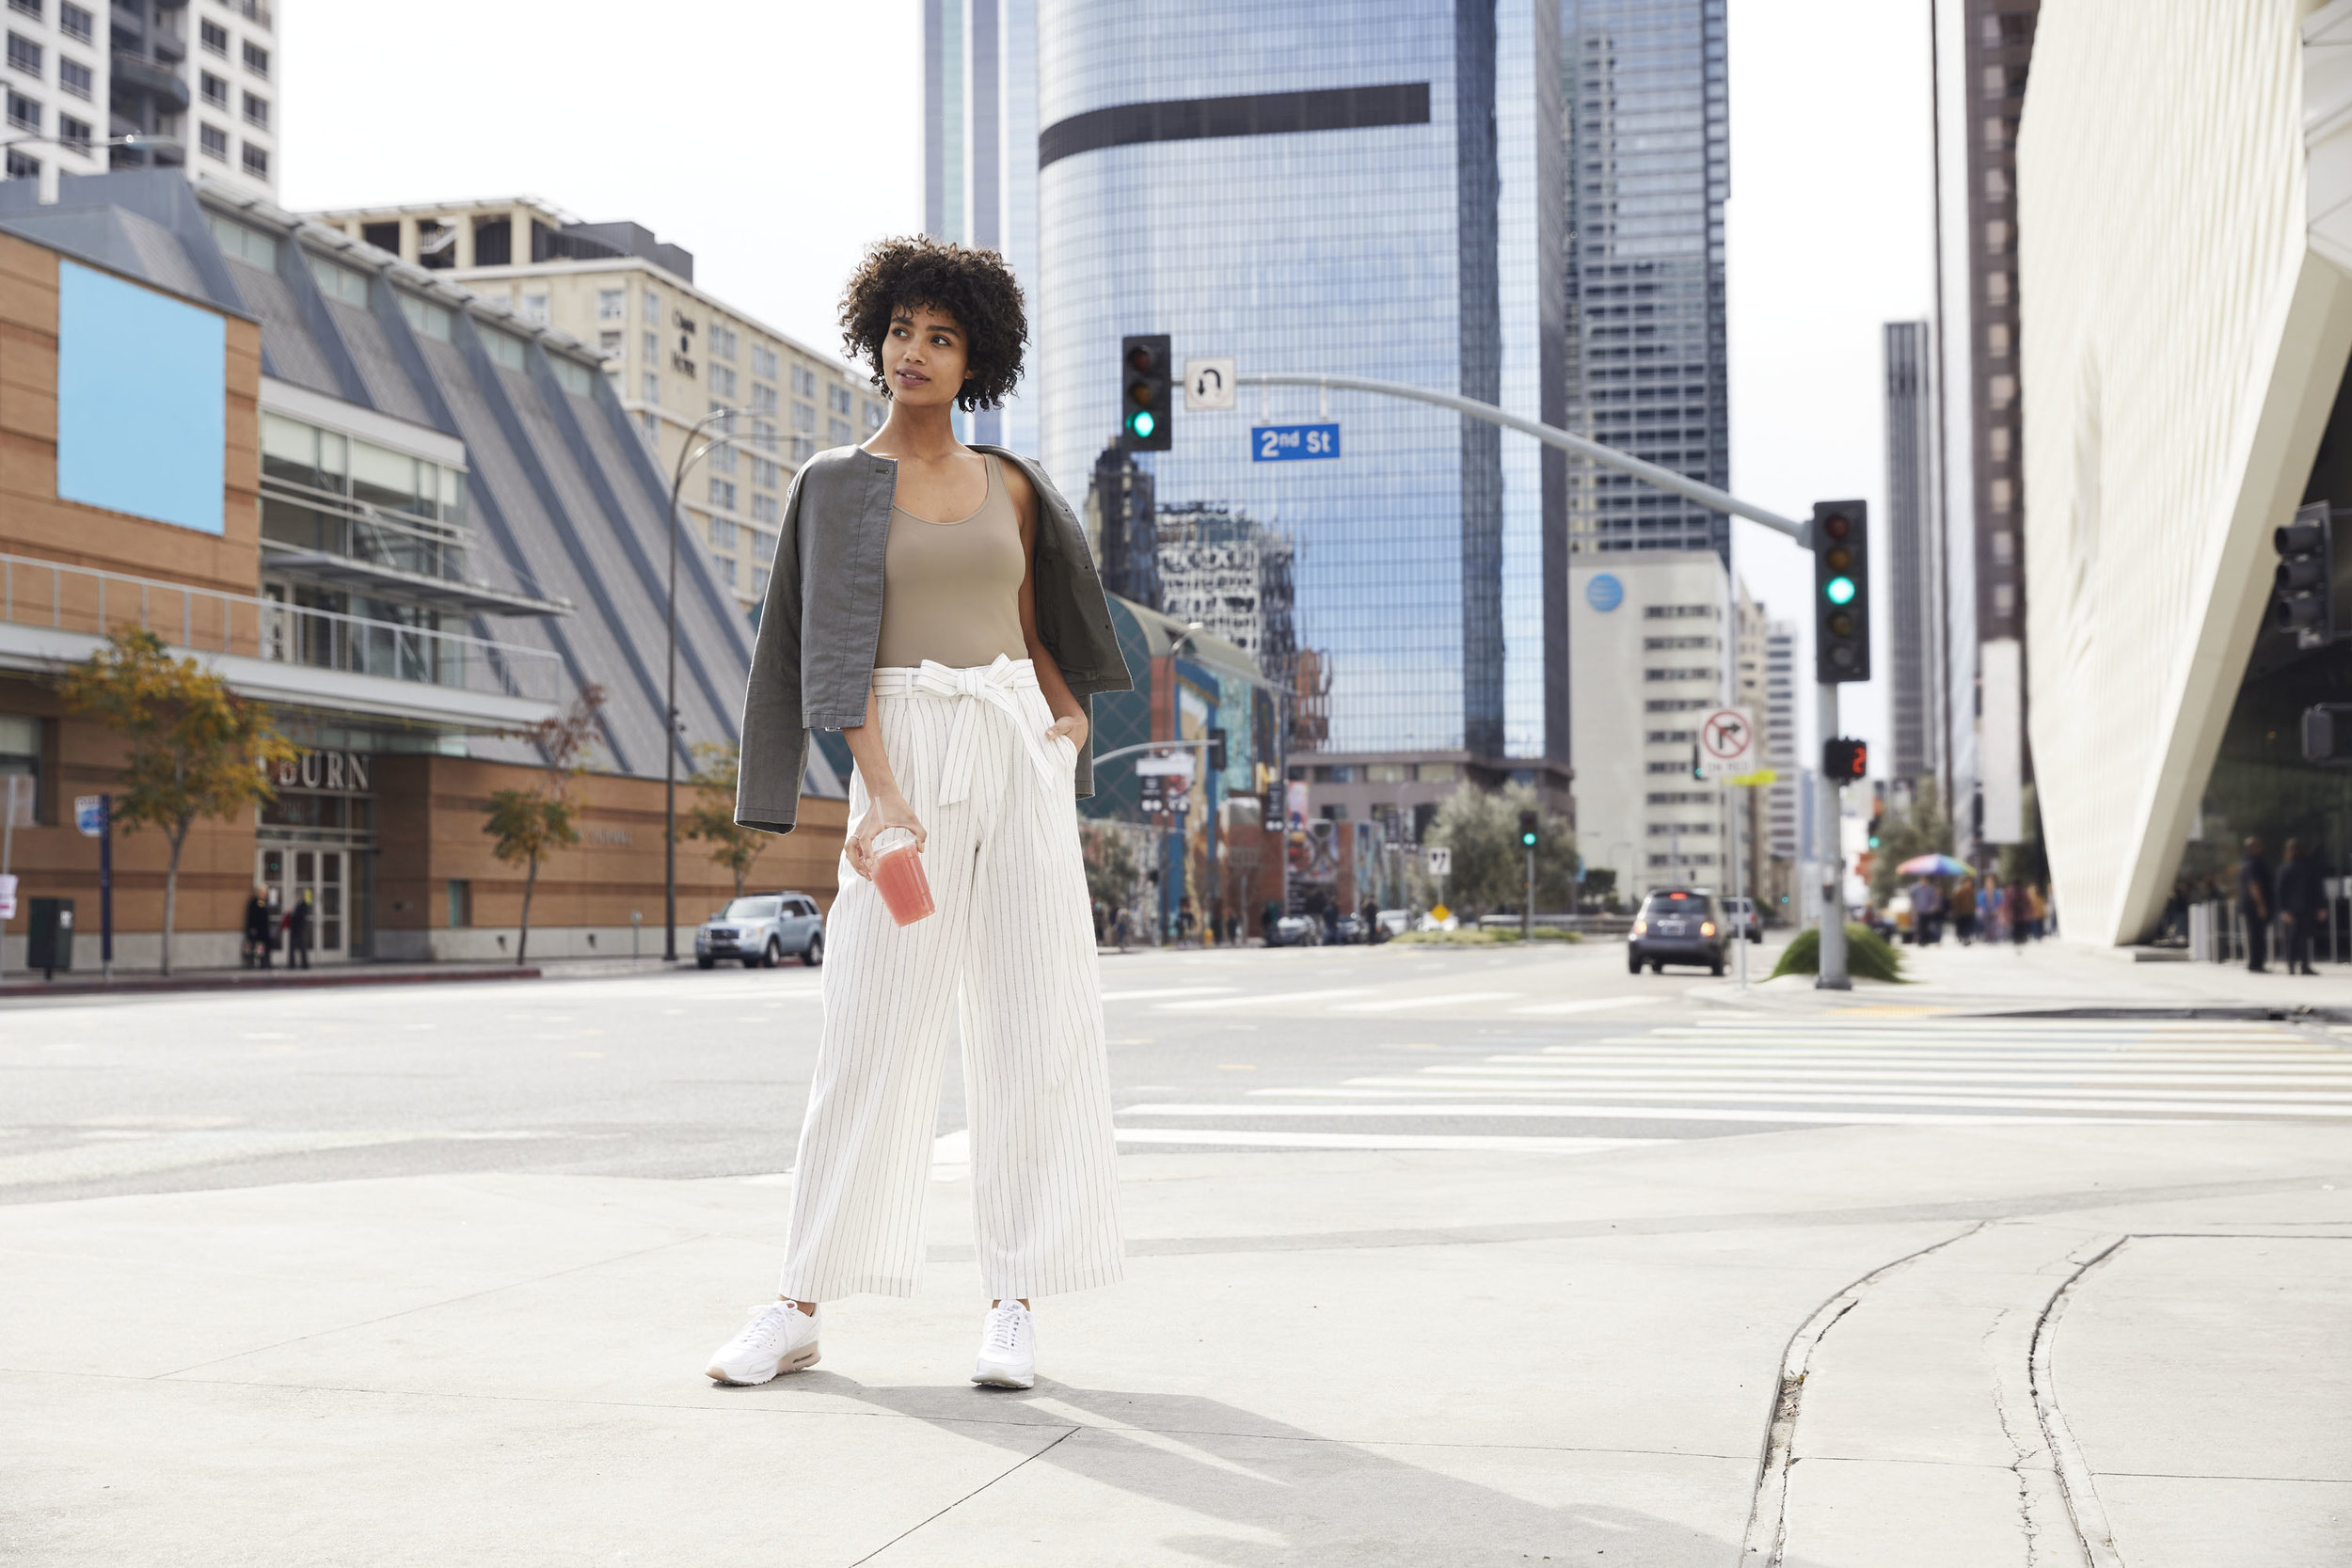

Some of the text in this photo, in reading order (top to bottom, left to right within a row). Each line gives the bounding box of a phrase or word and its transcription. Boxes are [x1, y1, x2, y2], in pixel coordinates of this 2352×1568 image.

[1261, 429, 1331, 458] 2nd St
[1851, 747, 1867, 775] 2
